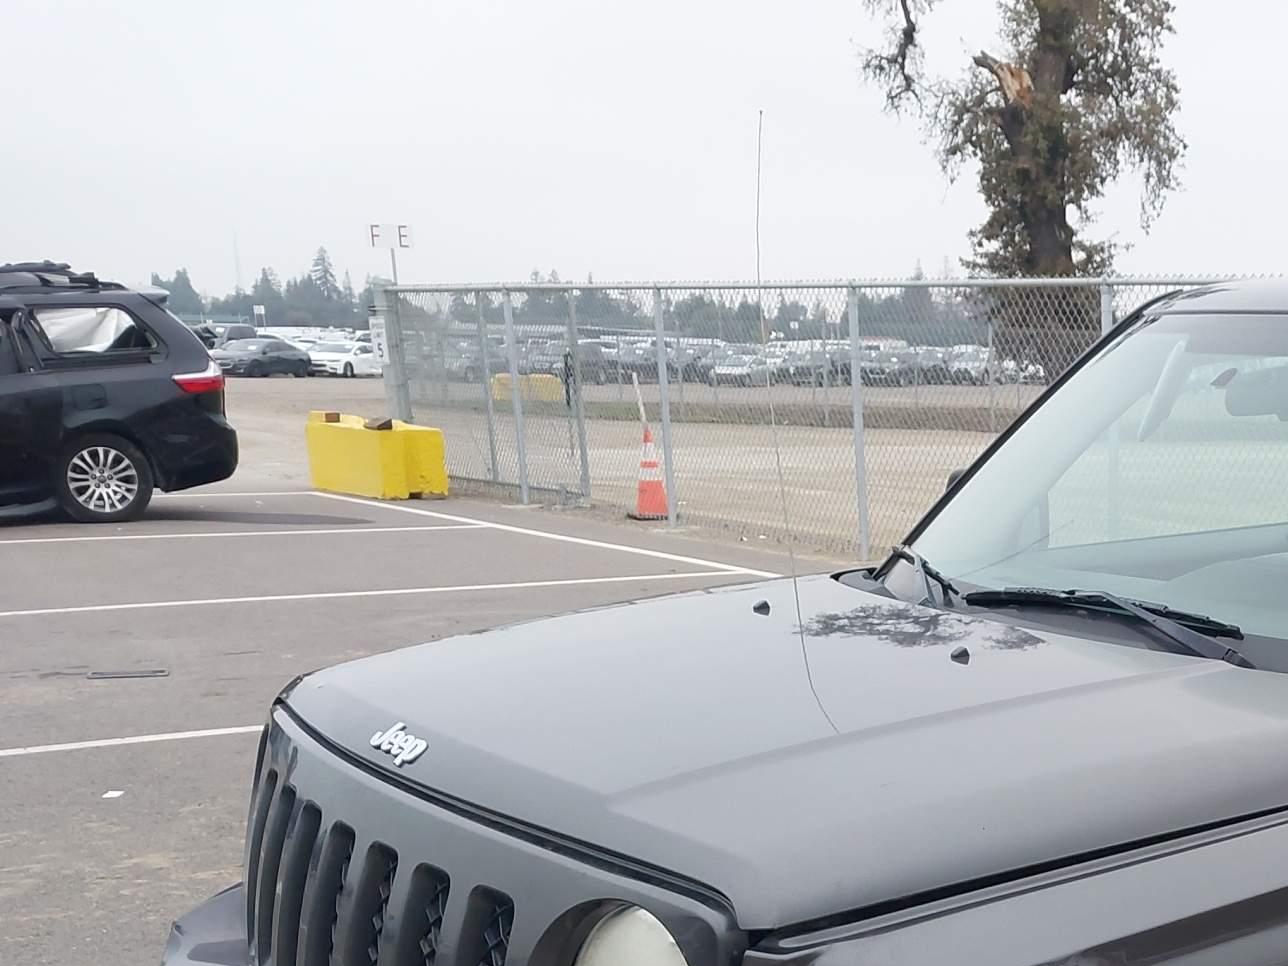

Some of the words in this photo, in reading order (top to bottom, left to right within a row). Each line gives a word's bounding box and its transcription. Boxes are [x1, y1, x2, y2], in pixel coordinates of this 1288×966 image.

[370, 224, 380, 247] F
[397, 224, 410, 248] E
[369, 721, 428, 767] Jeep
